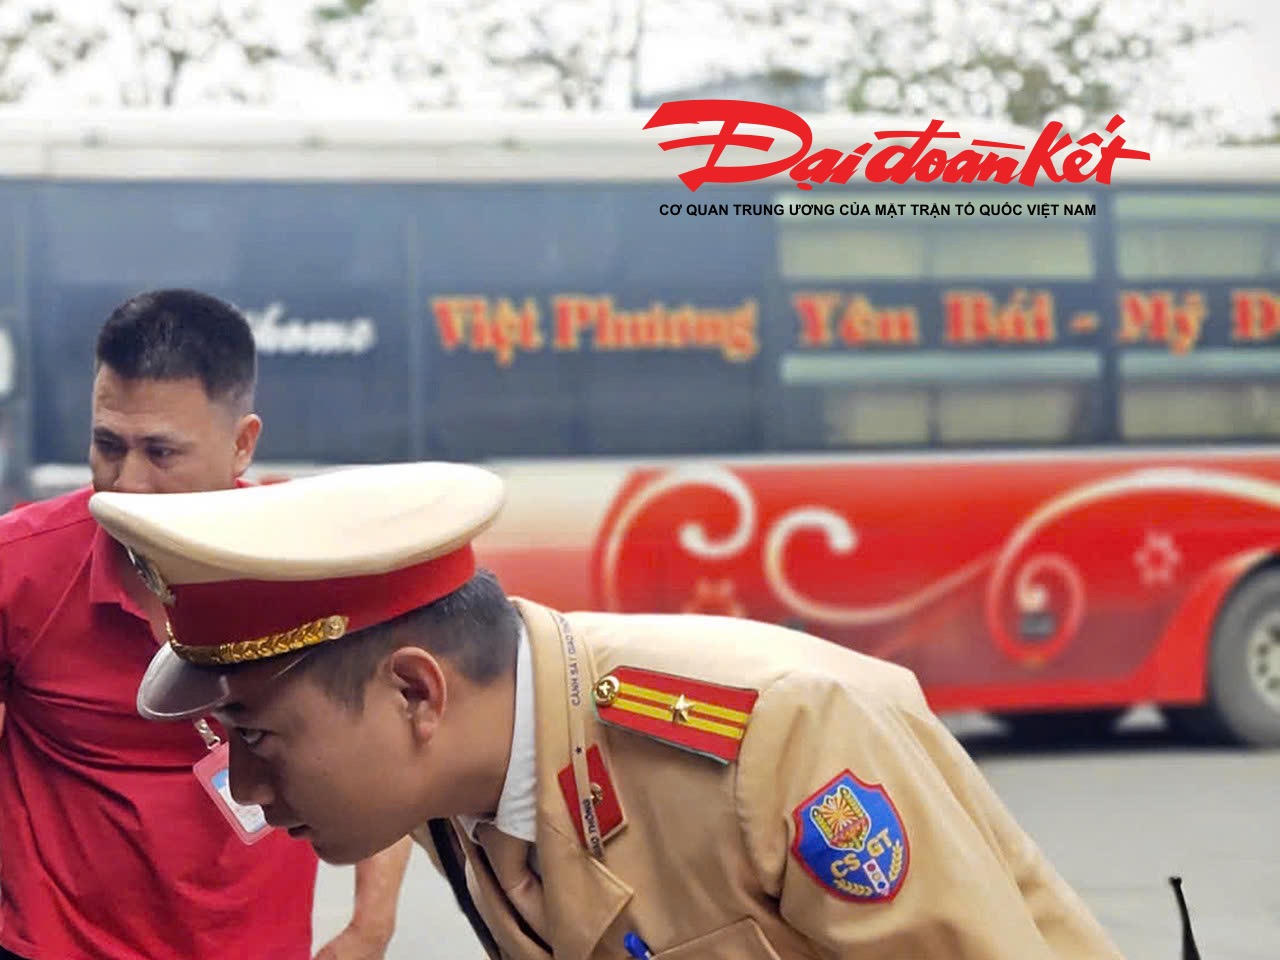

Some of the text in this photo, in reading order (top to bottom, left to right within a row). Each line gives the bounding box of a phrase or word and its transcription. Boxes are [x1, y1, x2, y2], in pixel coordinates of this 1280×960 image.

[431, 294, 543, 367] Việt
[794, 291, 918, 347] Yên
[943, 288, 1054, 344] Bái
[830, 828, 892, 877] CS GT
